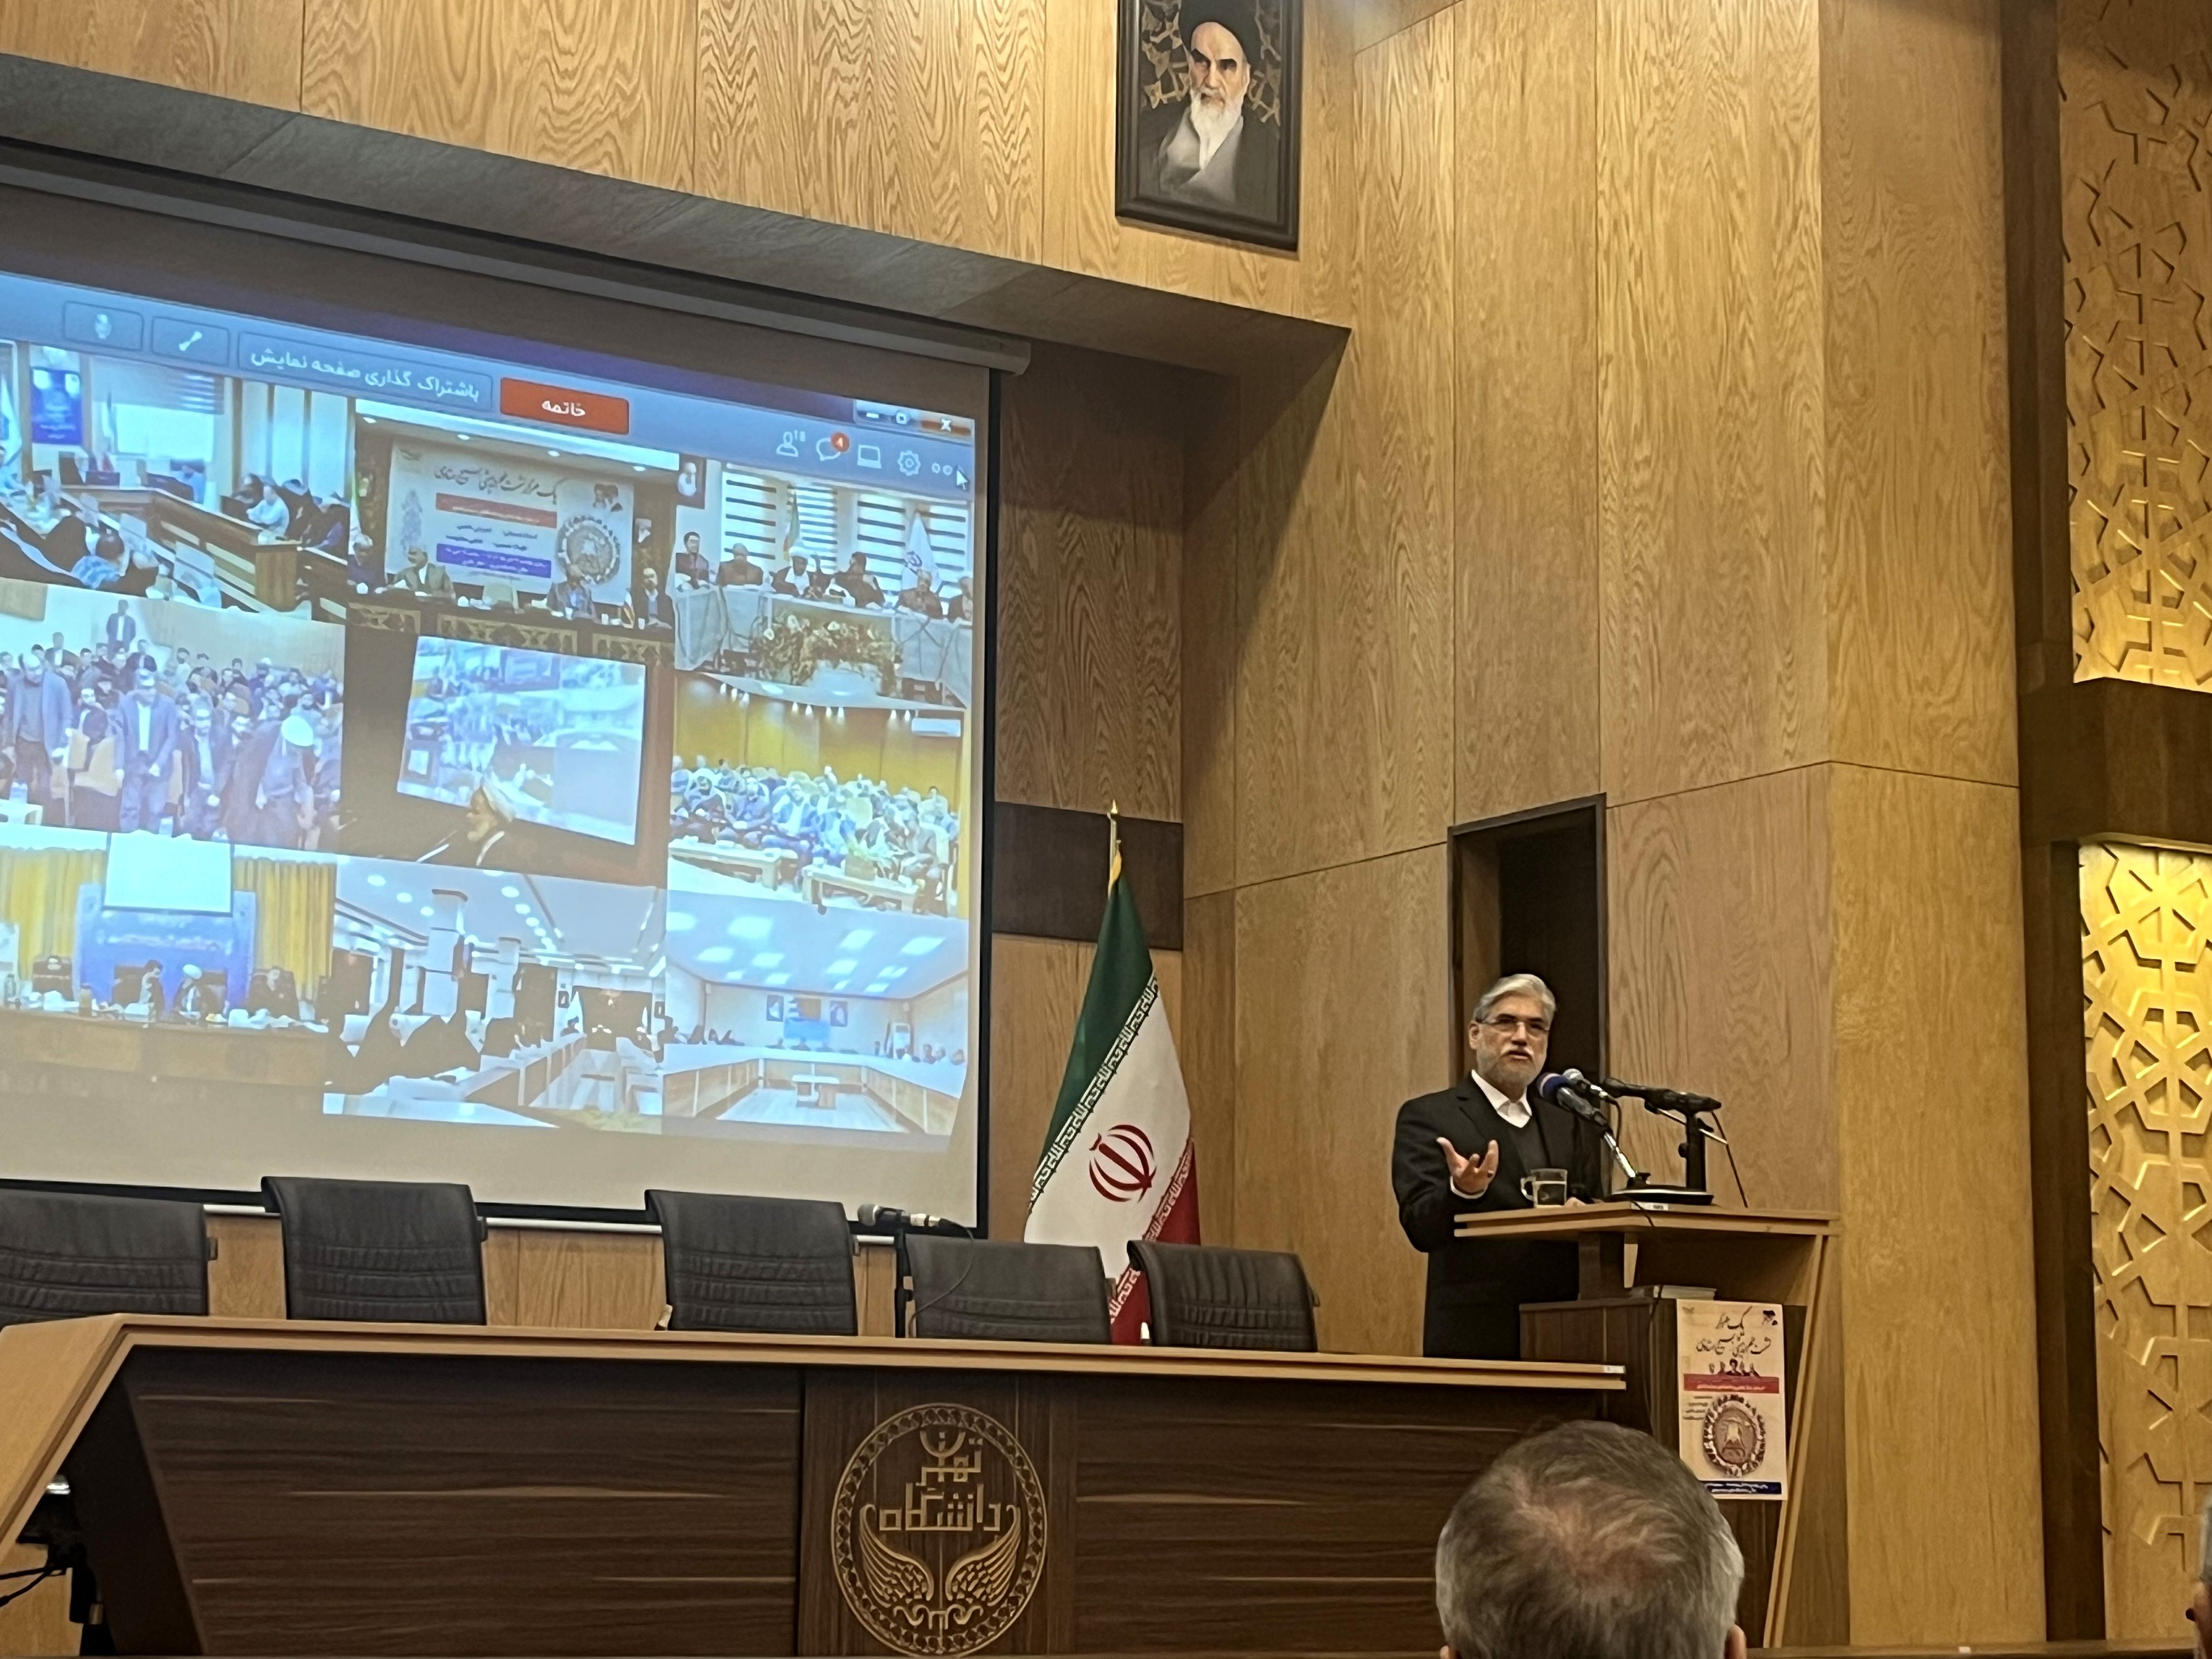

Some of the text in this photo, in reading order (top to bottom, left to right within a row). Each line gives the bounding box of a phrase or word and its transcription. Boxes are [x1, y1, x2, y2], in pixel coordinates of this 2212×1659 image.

[251, 347, 307, 368] نمایش
[311, 359, 360, 378] صفحه
[364, 369, 411, 387] گذاری
[541, 400, 586, 416] خاتمه
[879, 1483, 1000, 1531] دانشگاه
